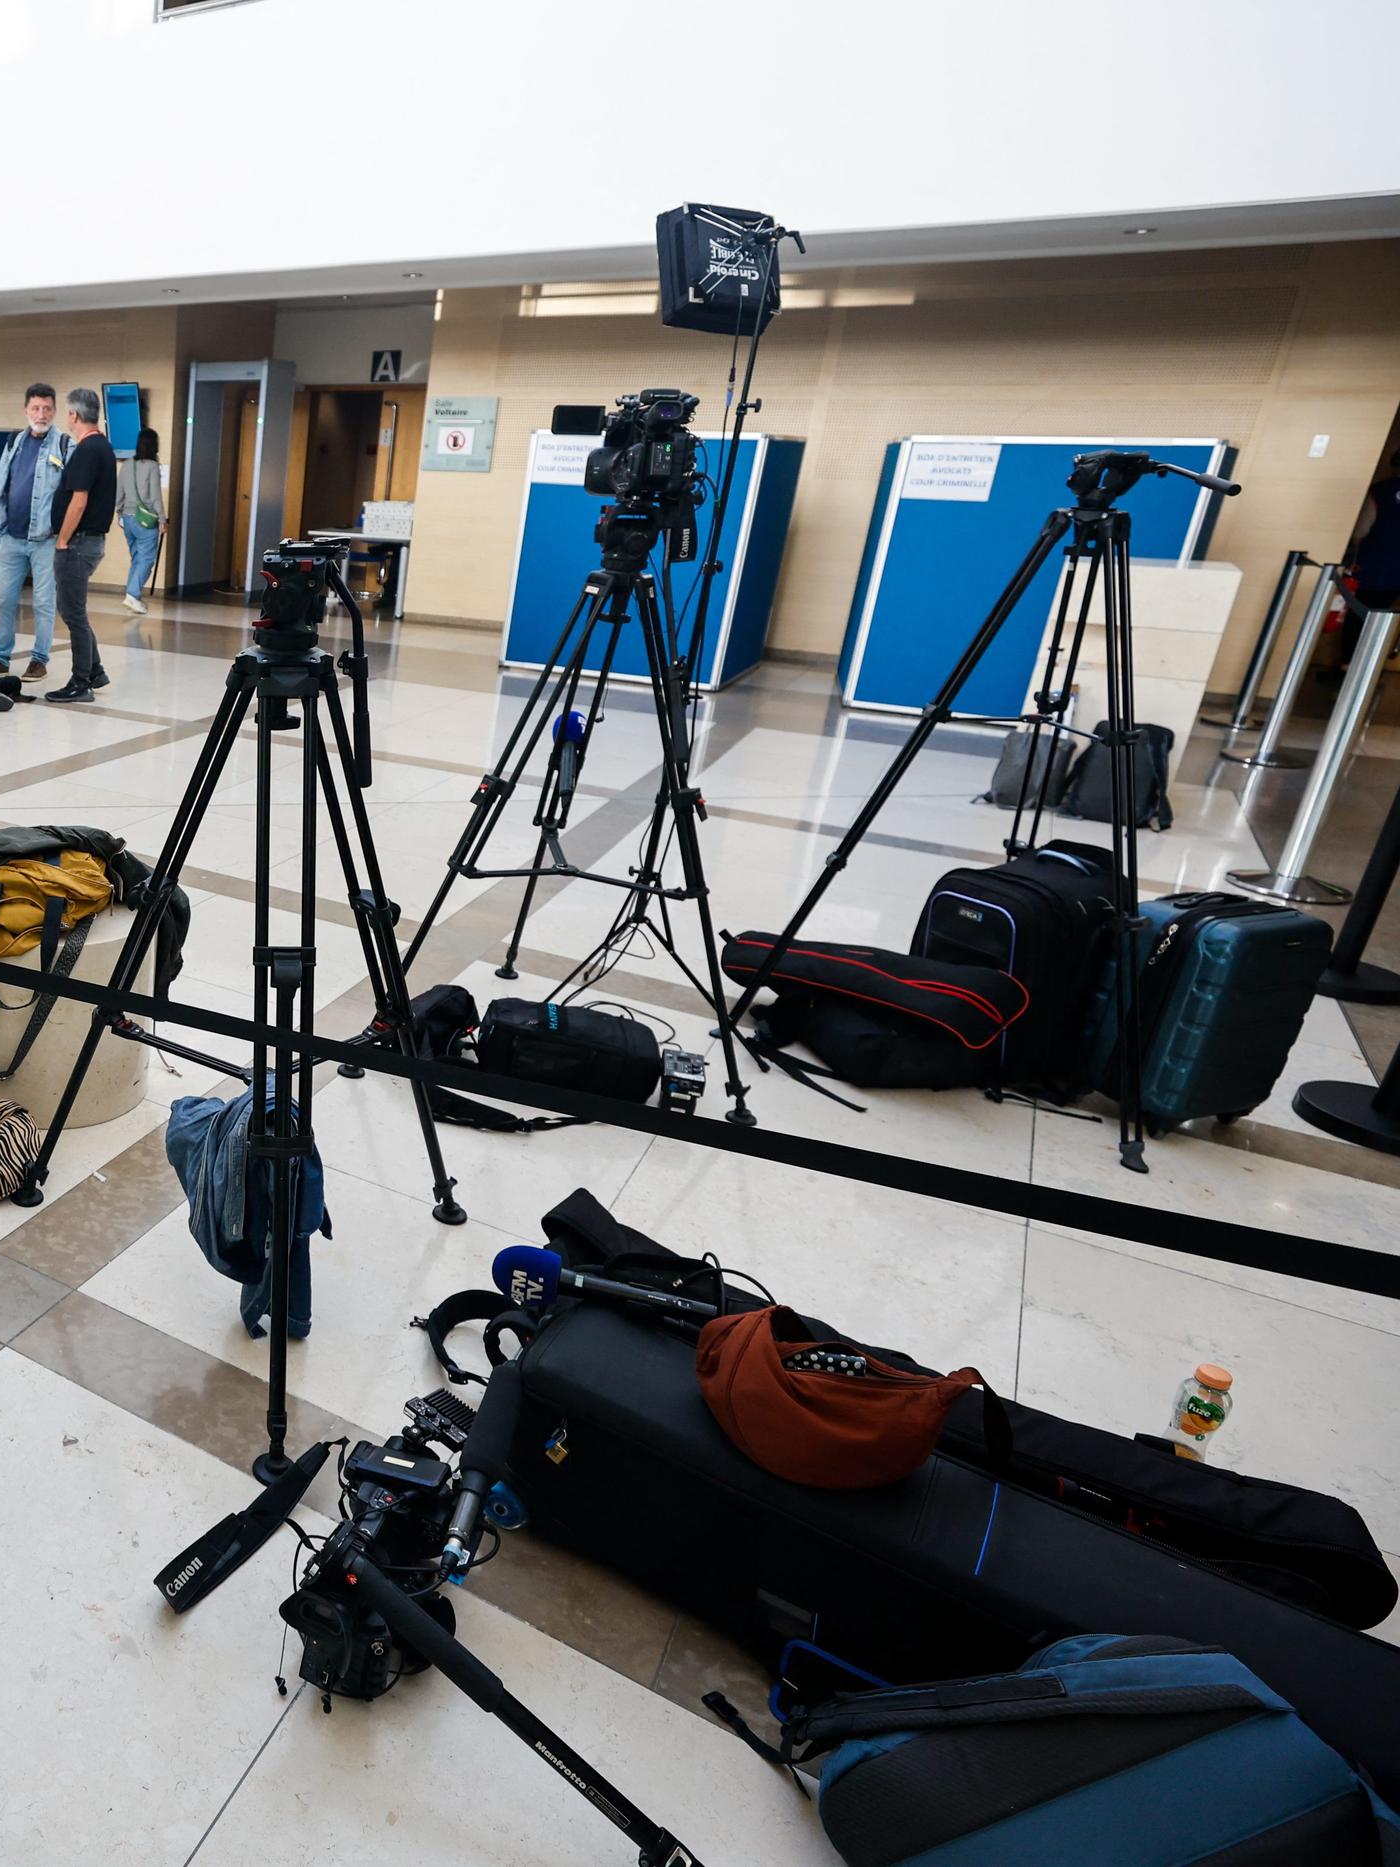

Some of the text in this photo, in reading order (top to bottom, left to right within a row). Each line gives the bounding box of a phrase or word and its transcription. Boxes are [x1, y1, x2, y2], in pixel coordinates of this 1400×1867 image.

[709, 264, 760, 281] Cineroid
[373, 351, 397, 381] A
[435, 408, 469, 416] Voltaire
[930, 466, 972, 475] AVOCATS
[680, 528, 691, 558] Canon
[1188, 1403, 1211, 1417] fuze
[166, 1556, 203, 1597] Canon
[535, 1741, 586, 1790] Manfrotto
